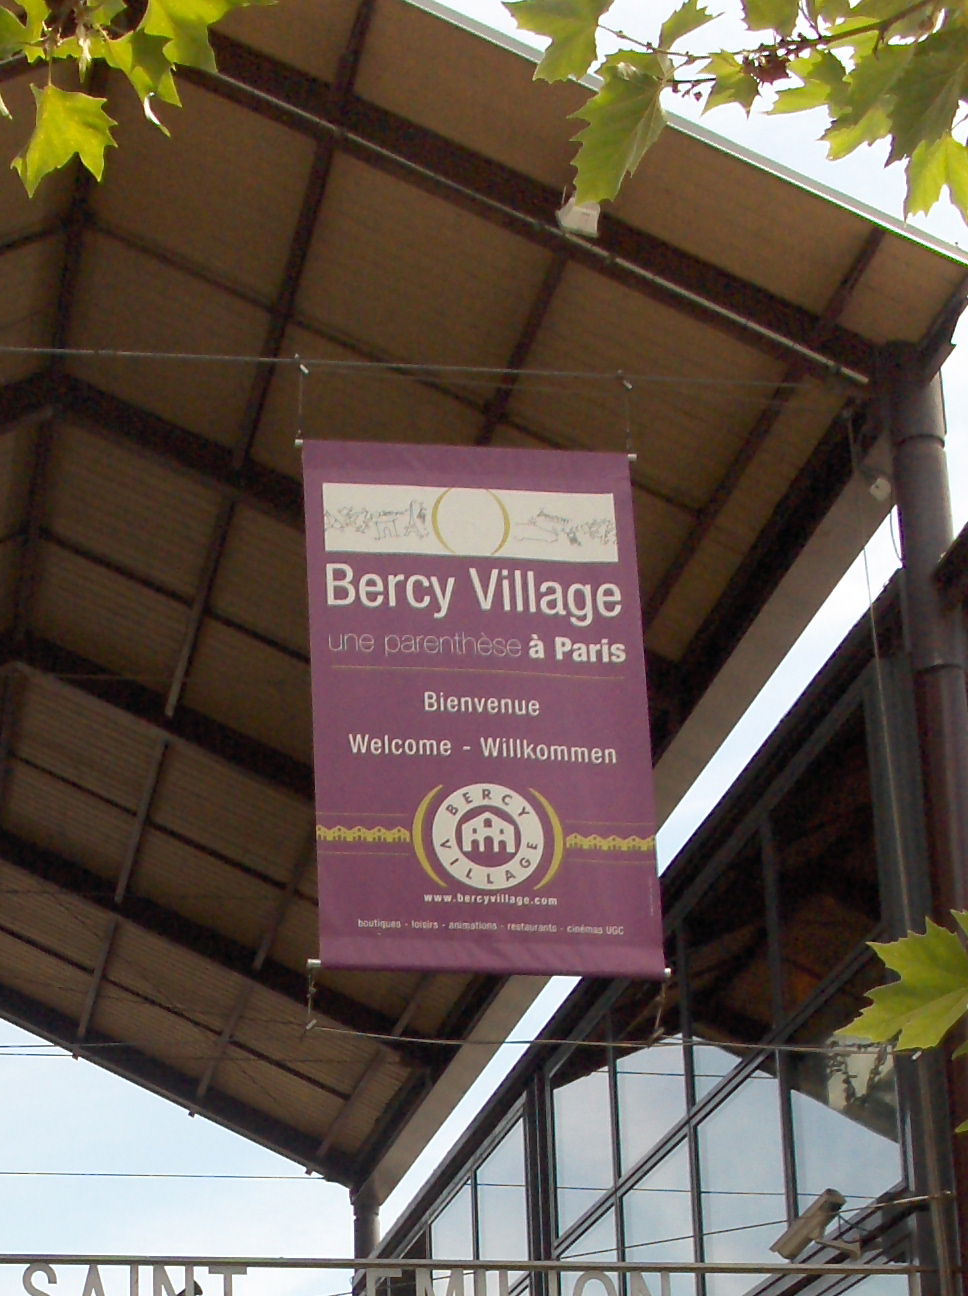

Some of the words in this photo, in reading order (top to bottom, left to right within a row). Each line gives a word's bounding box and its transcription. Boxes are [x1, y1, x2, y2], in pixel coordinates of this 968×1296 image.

[326, 562, 456, 619] Bercy
[468, 567, 623, 628] Village
[328, 632, 375, 652] une
[384, 632, 522, 657] parenthèse
[528, 634, 546, 659] à
[554, 636, 628, 663] Paris
[423, 691, 541, 717] Bienvenue
[348, 733, 453, 757] Welcome
[479, 736, 618, 765] Willkommen
[445, 788, 531, 818] BERCY
[438, 838, 539, 885] VILLAGE
[423, 892, 558, 906] www.bercyvillage.com
[605, 925, 625, 936] UGC
